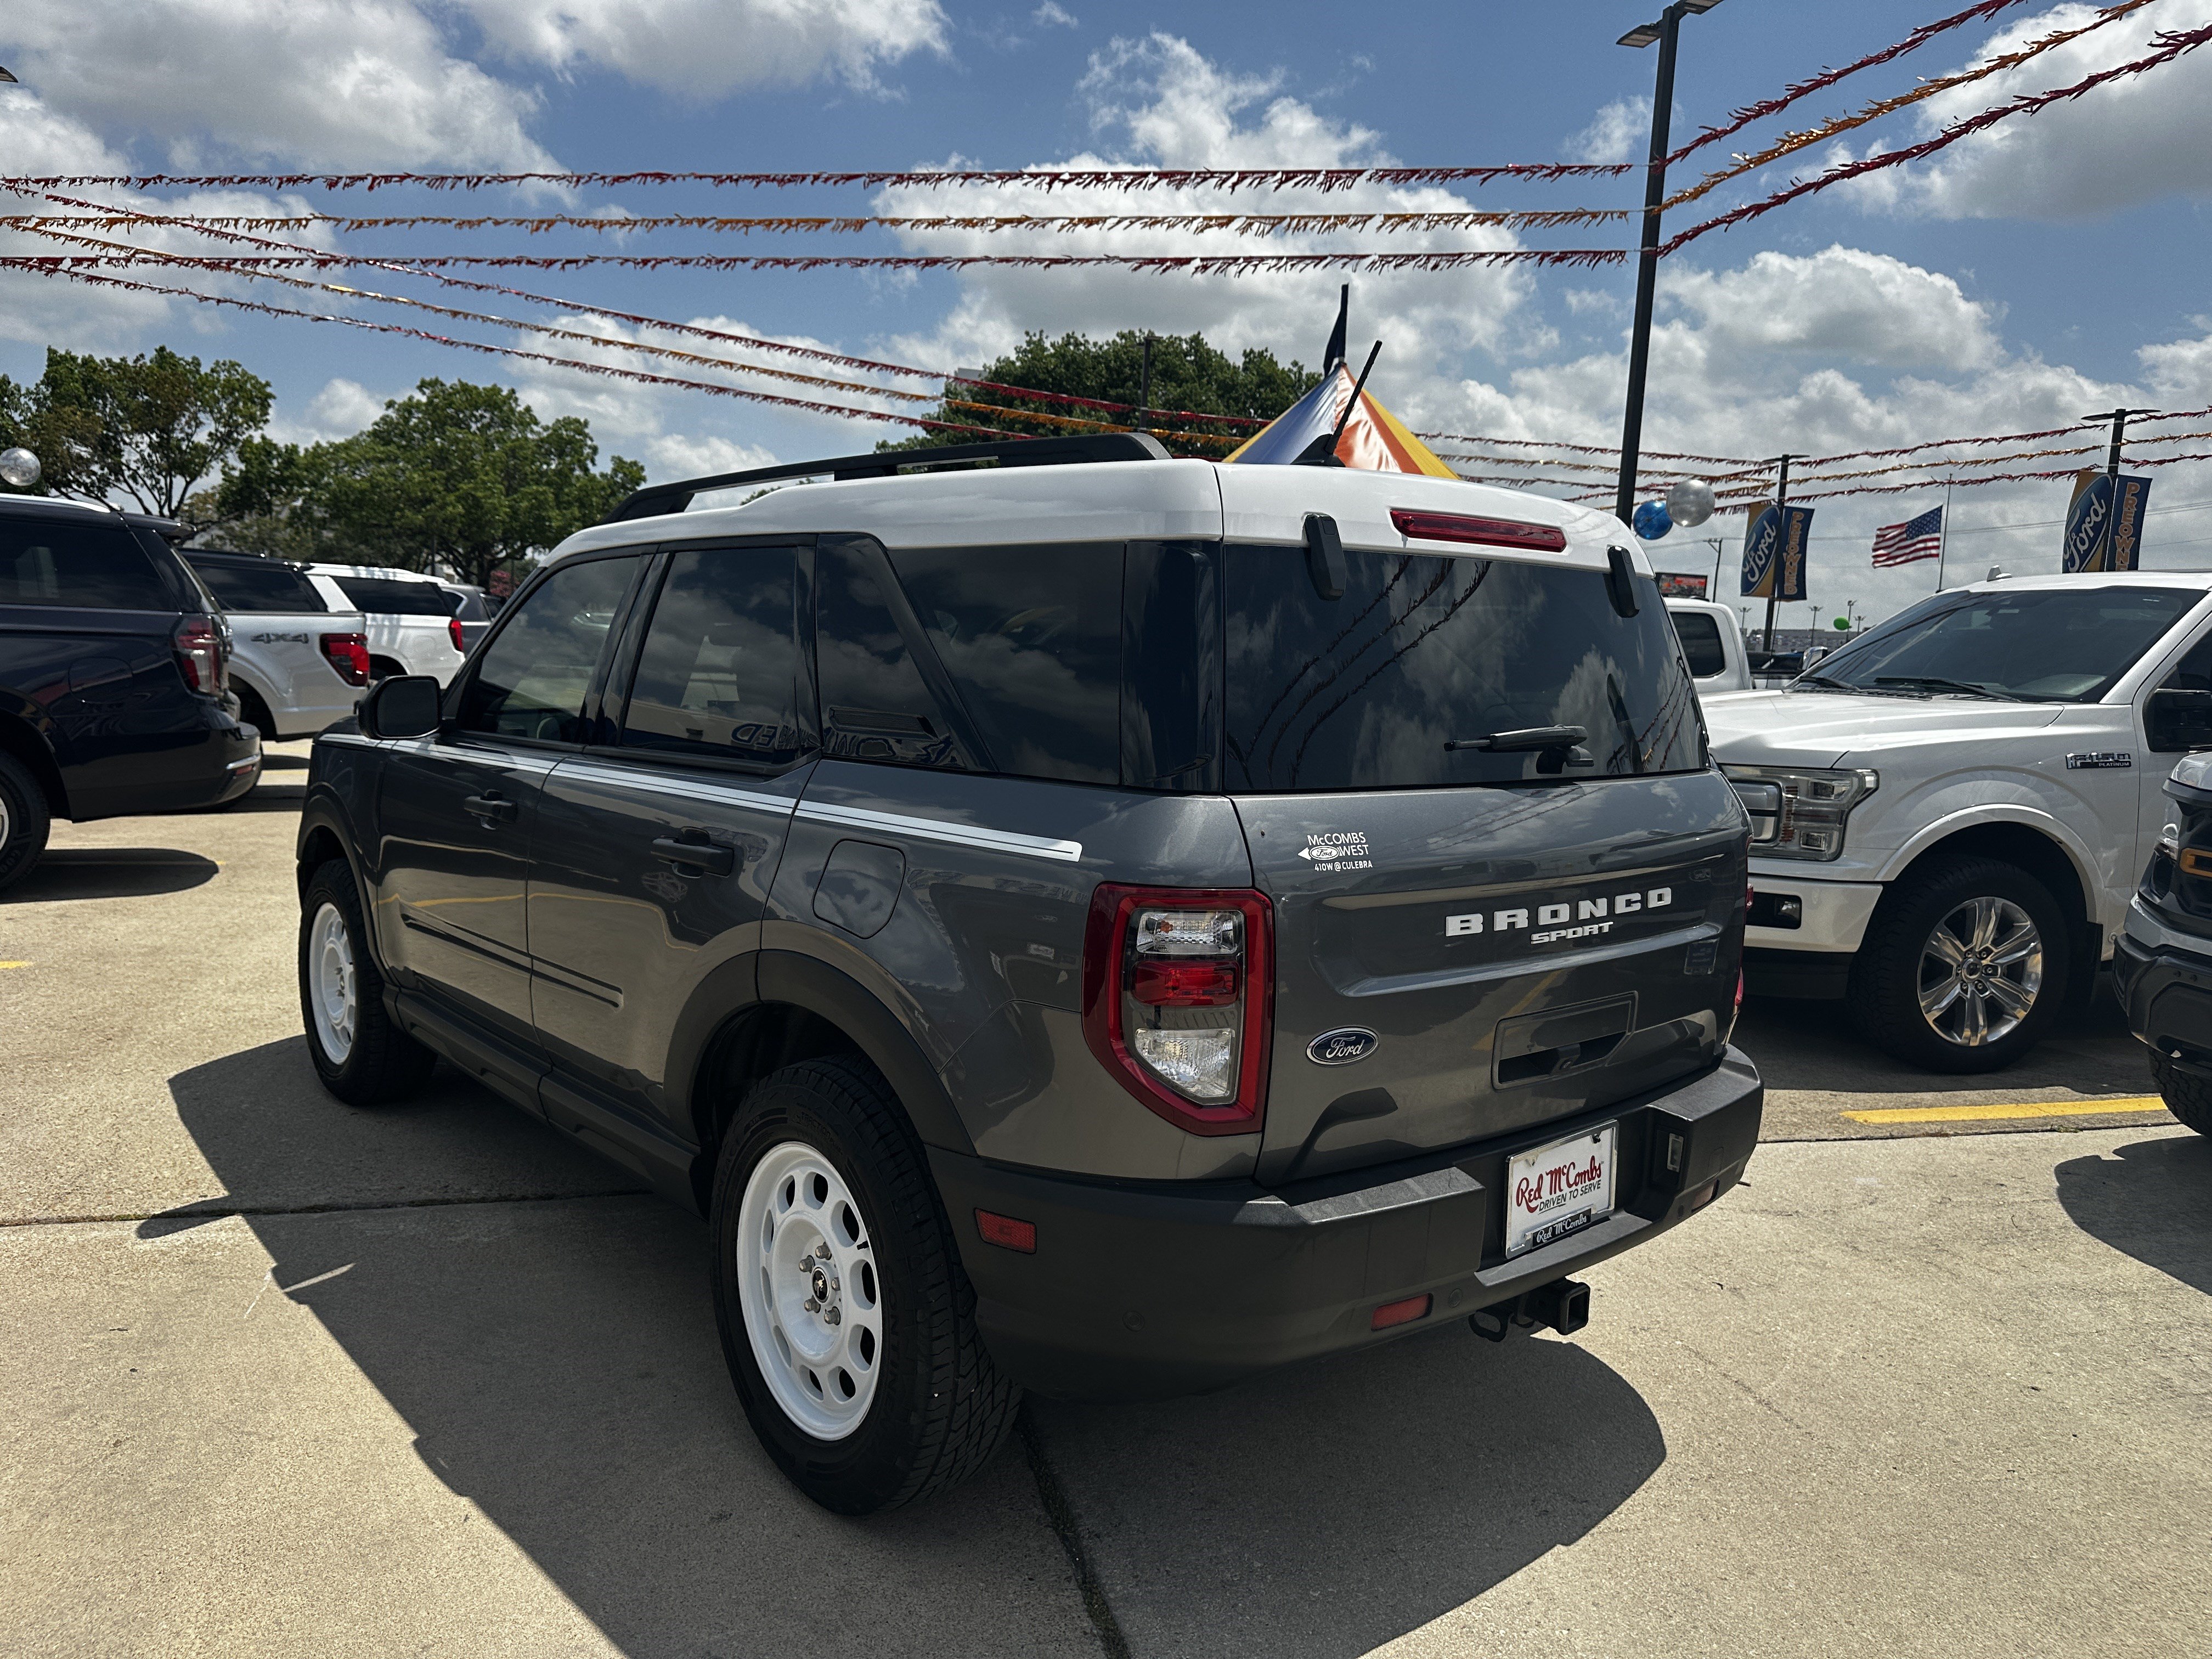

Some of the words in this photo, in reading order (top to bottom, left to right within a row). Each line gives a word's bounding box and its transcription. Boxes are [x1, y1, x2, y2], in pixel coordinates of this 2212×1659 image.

[2063, 492, 2106, 573] Ford
[2115, 482, 2140, 571] PREOWN
[1741, 521, 1776, 583] Ford
[1783, 511, 1804, 595] PREOWNED
[1307, 832, 1366, 846] McCOMBS
[1338, 844, 1369, 856] WEST
[1445, 887, 1672, 937] BRONCO
[1530, 921, 1613, 945] SPORT
[1325, 1036, 1365, 1058] Ford
[1516, 1173, 1544, 1214] Red
[1545, 1155, 1601, 1195] McCombs
[1538, 1193, 1567, 1212] DRIVEN
[1568, 1189, 1579, 1200] TO
[1579, 1179, 1601, 1197] SERVE
[1536, 1227, 1552, 1243] Red
[1553, 1213, 1587, 1235] McCombs
